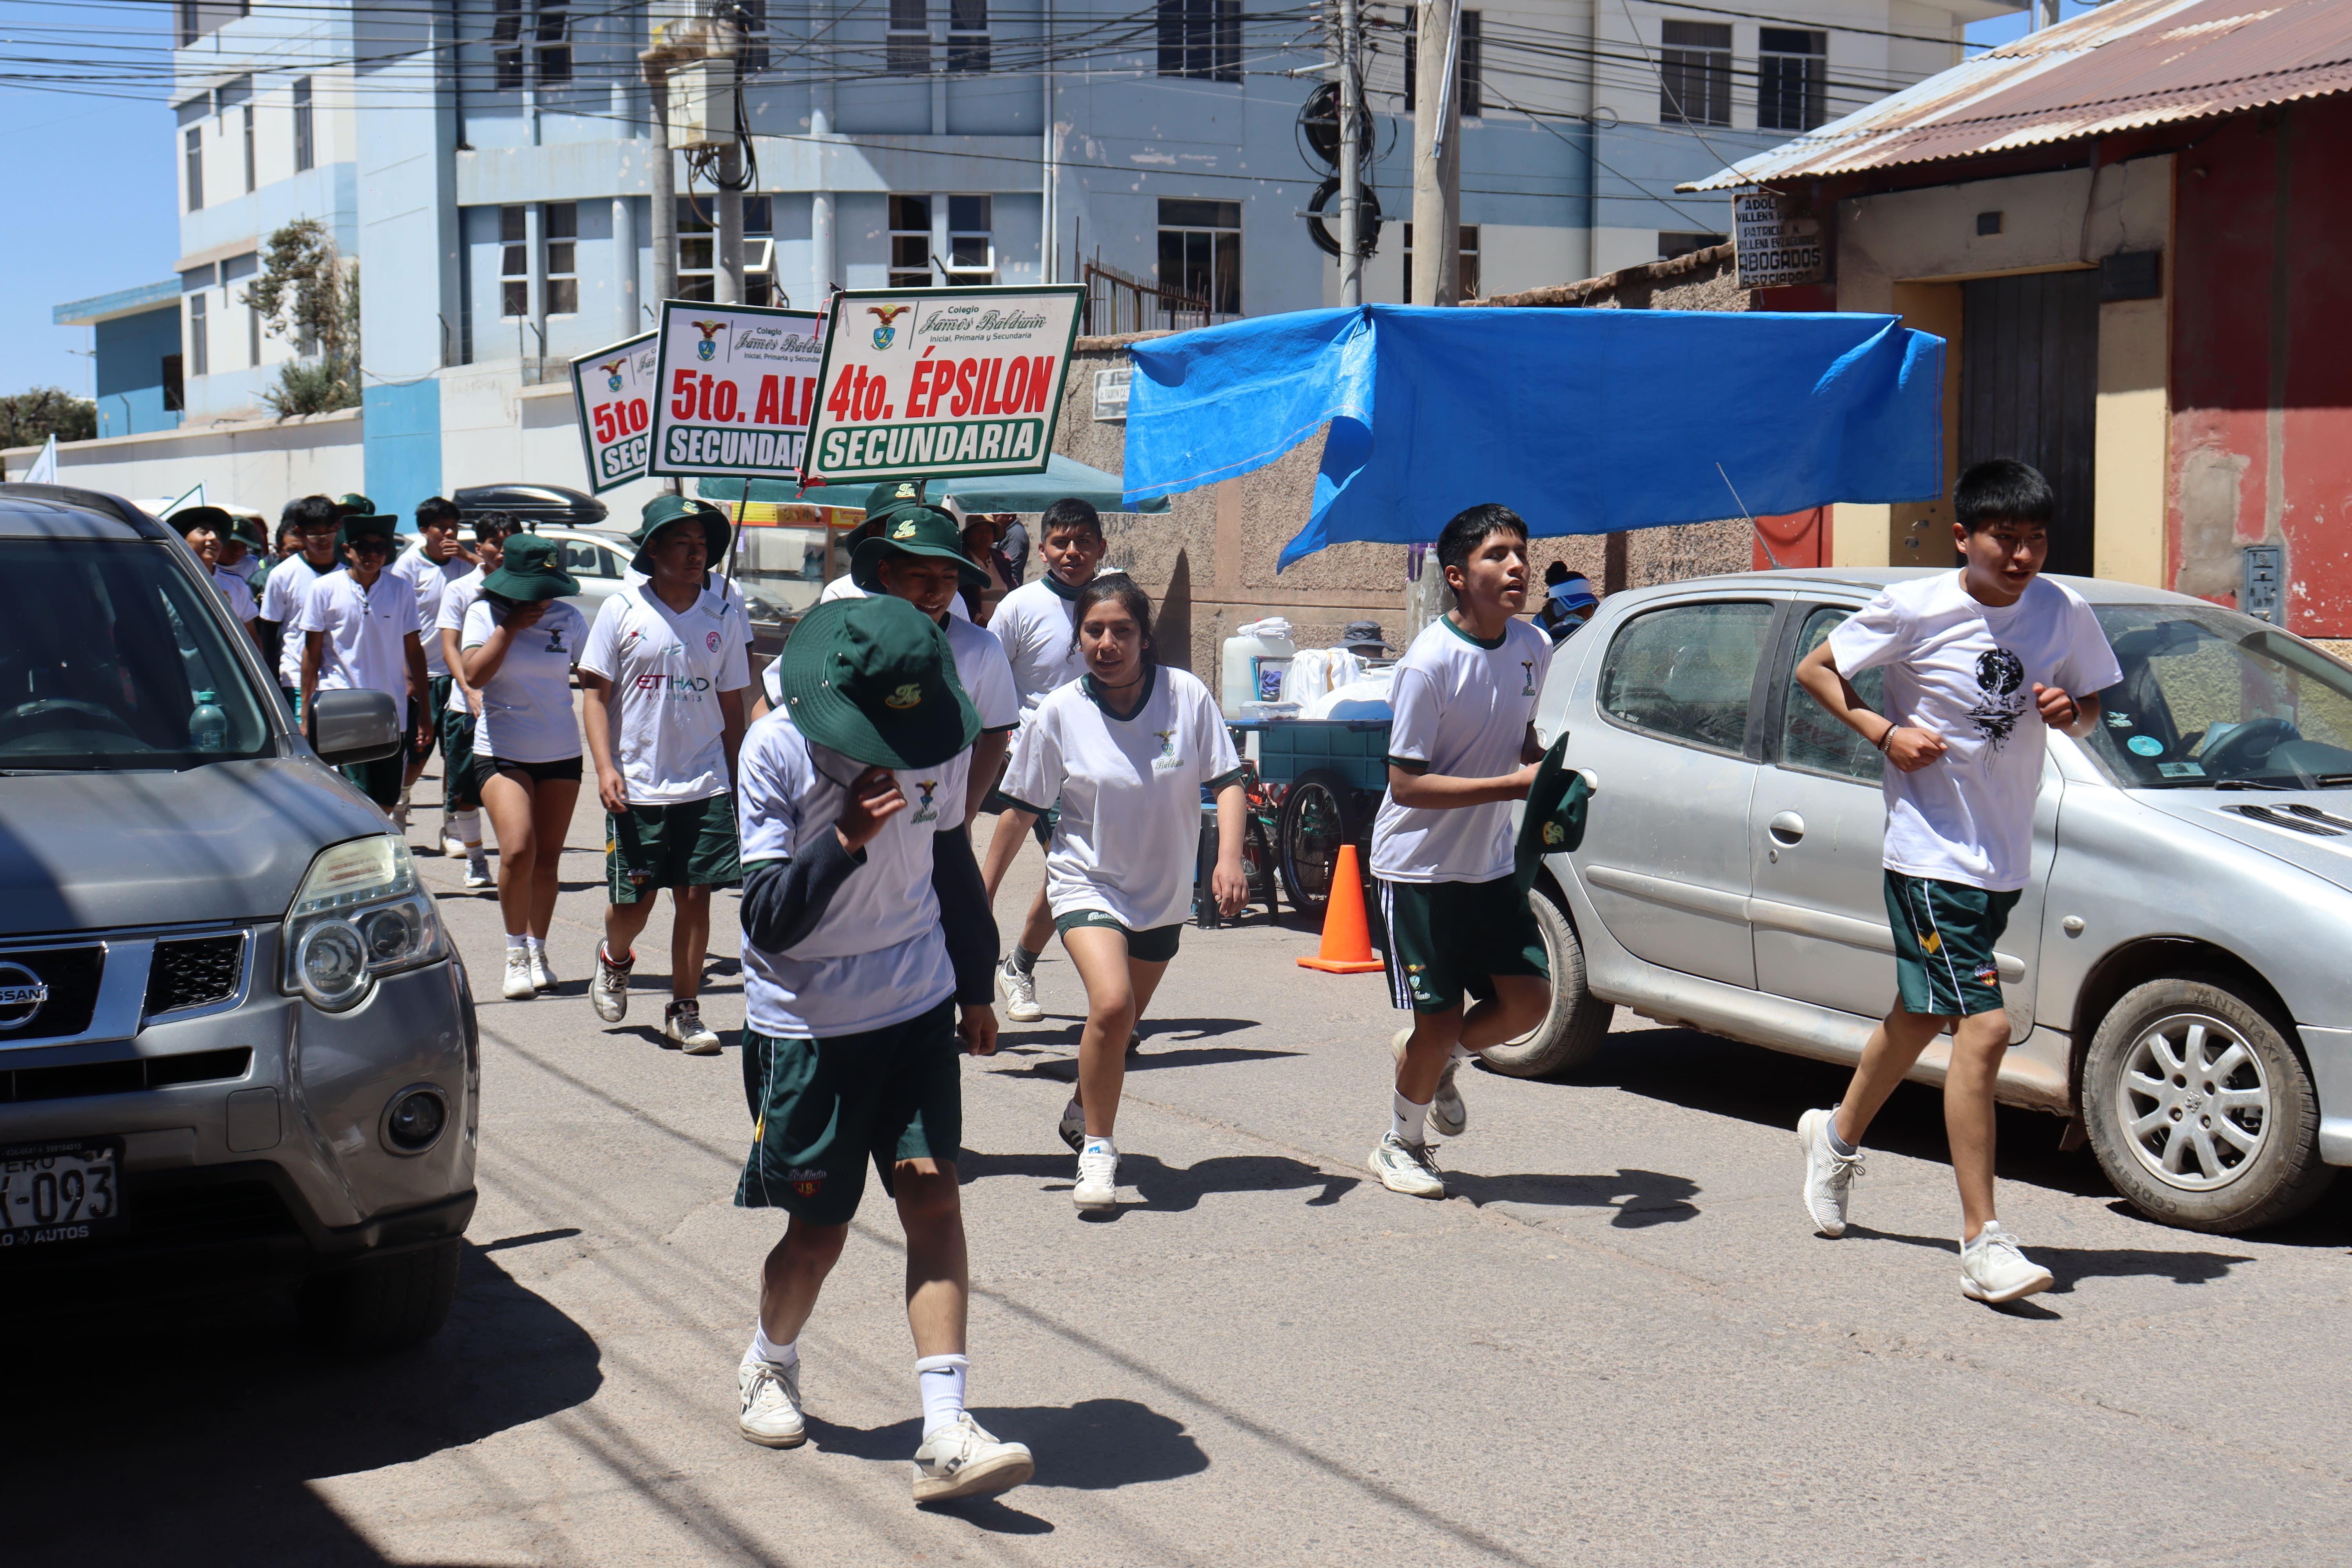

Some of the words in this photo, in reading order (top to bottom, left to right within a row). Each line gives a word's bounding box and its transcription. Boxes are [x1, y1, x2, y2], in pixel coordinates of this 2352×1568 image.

[1745, 198, 1779, 210] ADOL
[1737, 211, 1774, 222] VILLENA
[1744, 225, 1784, 237] PATRICIA
[1737, 238, 1768, 250] VILLENA
[1739, 247, 1821, 272] ABOGADOS
[1742, 270, 1813, 286] ASOCIADOS
[948, 306, 979, 314] Colegio
[918, 310, 974, 334] James
[975, 309, 1047, 332] Baldwin
[734, 330, 778, 350] James
[757, 327, 782, 336] Colegio
[993, 332, 1032, 340] Secundaria
[826, 364, 894, 421] 4to.
[905, 345, 1055, 418] ÉPSILON
[671, 368, 746, 423] 5to.
[823, 421, 1035, 468] SECUNDARIA
[604, 436, 649, 475] SEC
[637, 675, 710, 692] ETIHAD
[1155, 758, 1185, 770] Baldwin
[2249, 1016, 2281, 1064] TAXI
[2107, 1149, 2178, 1212] centara
[34, 1225, 90, 1244] AUTOS
